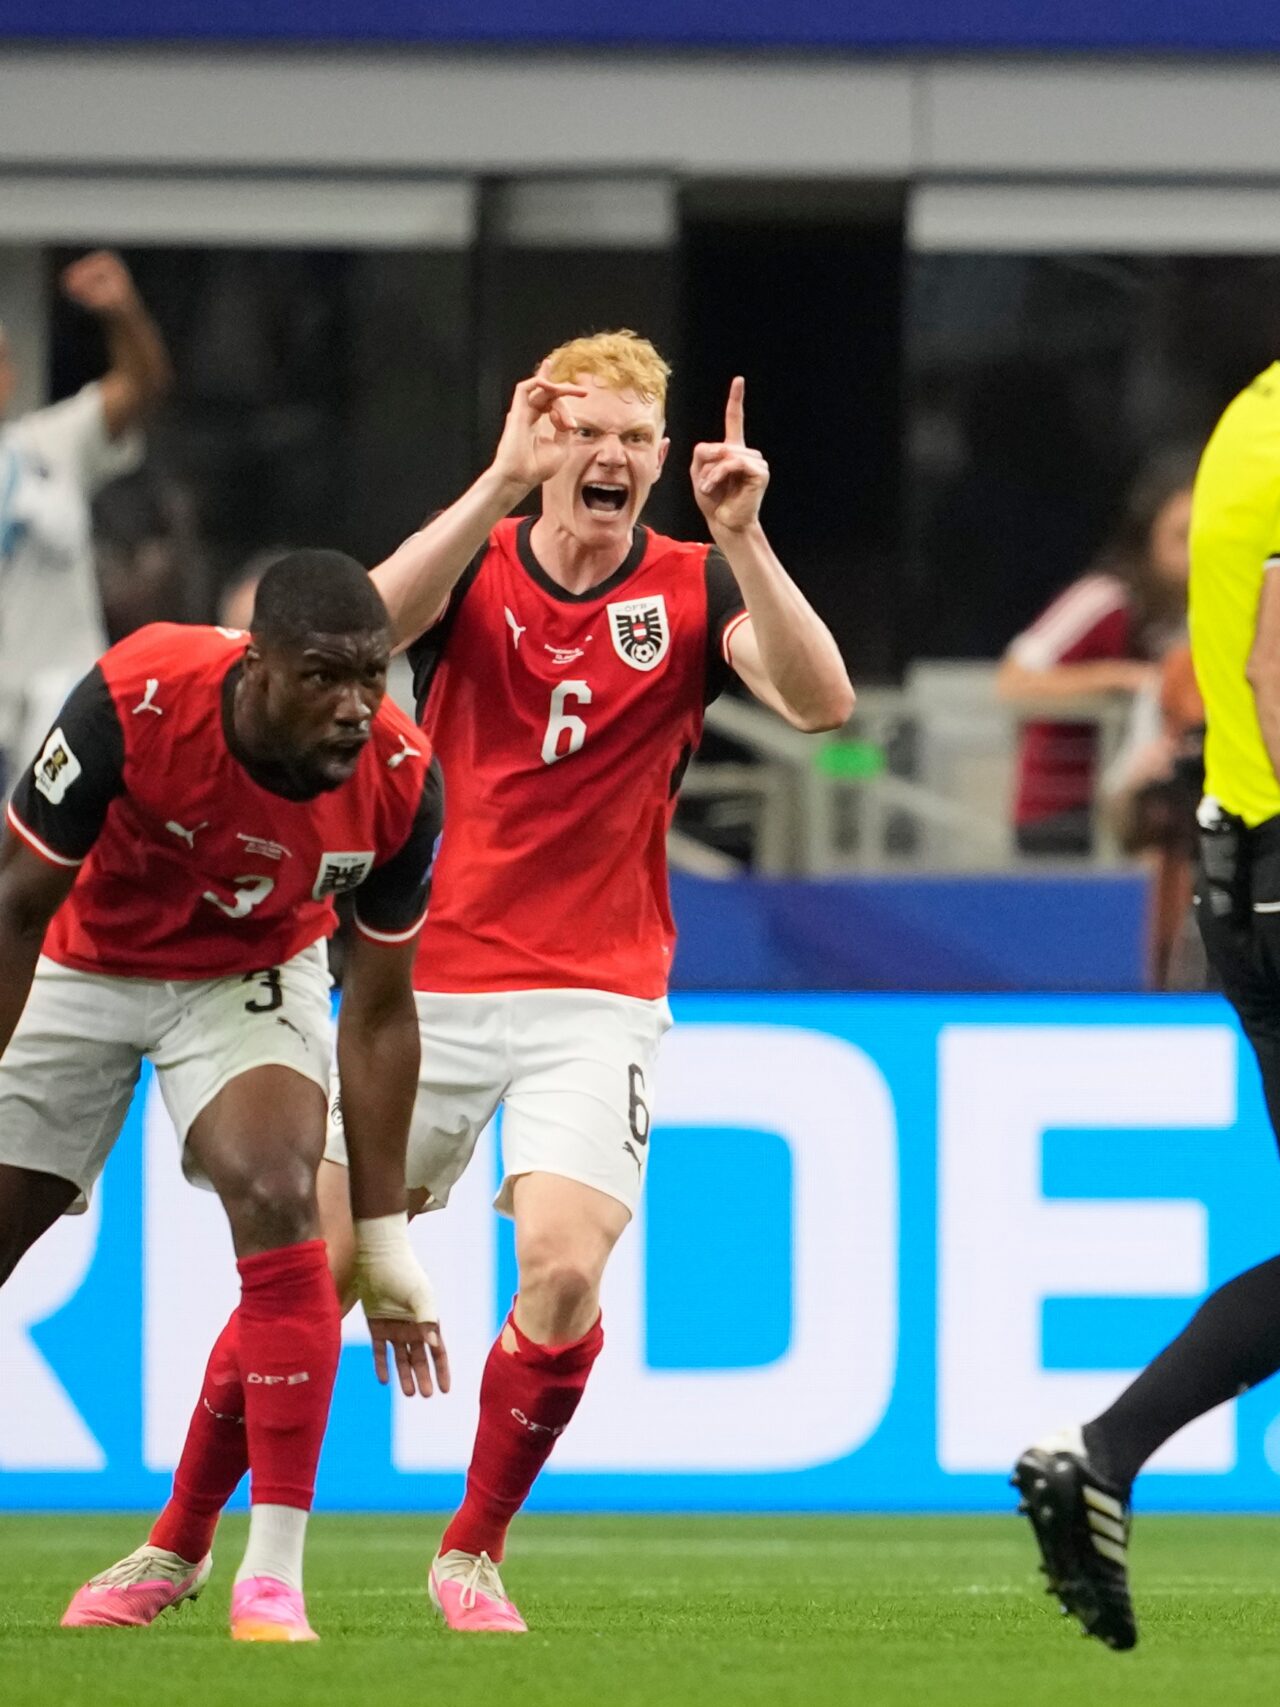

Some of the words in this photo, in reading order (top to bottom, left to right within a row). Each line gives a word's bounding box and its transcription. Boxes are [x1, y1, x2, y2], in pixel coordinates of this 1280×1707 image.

[541, 680, 593, 765] 6
[203, 874, 275, 919] 3
[241, 968, 284, 1014] 3
[627, 1063, 649, 1146] 6
